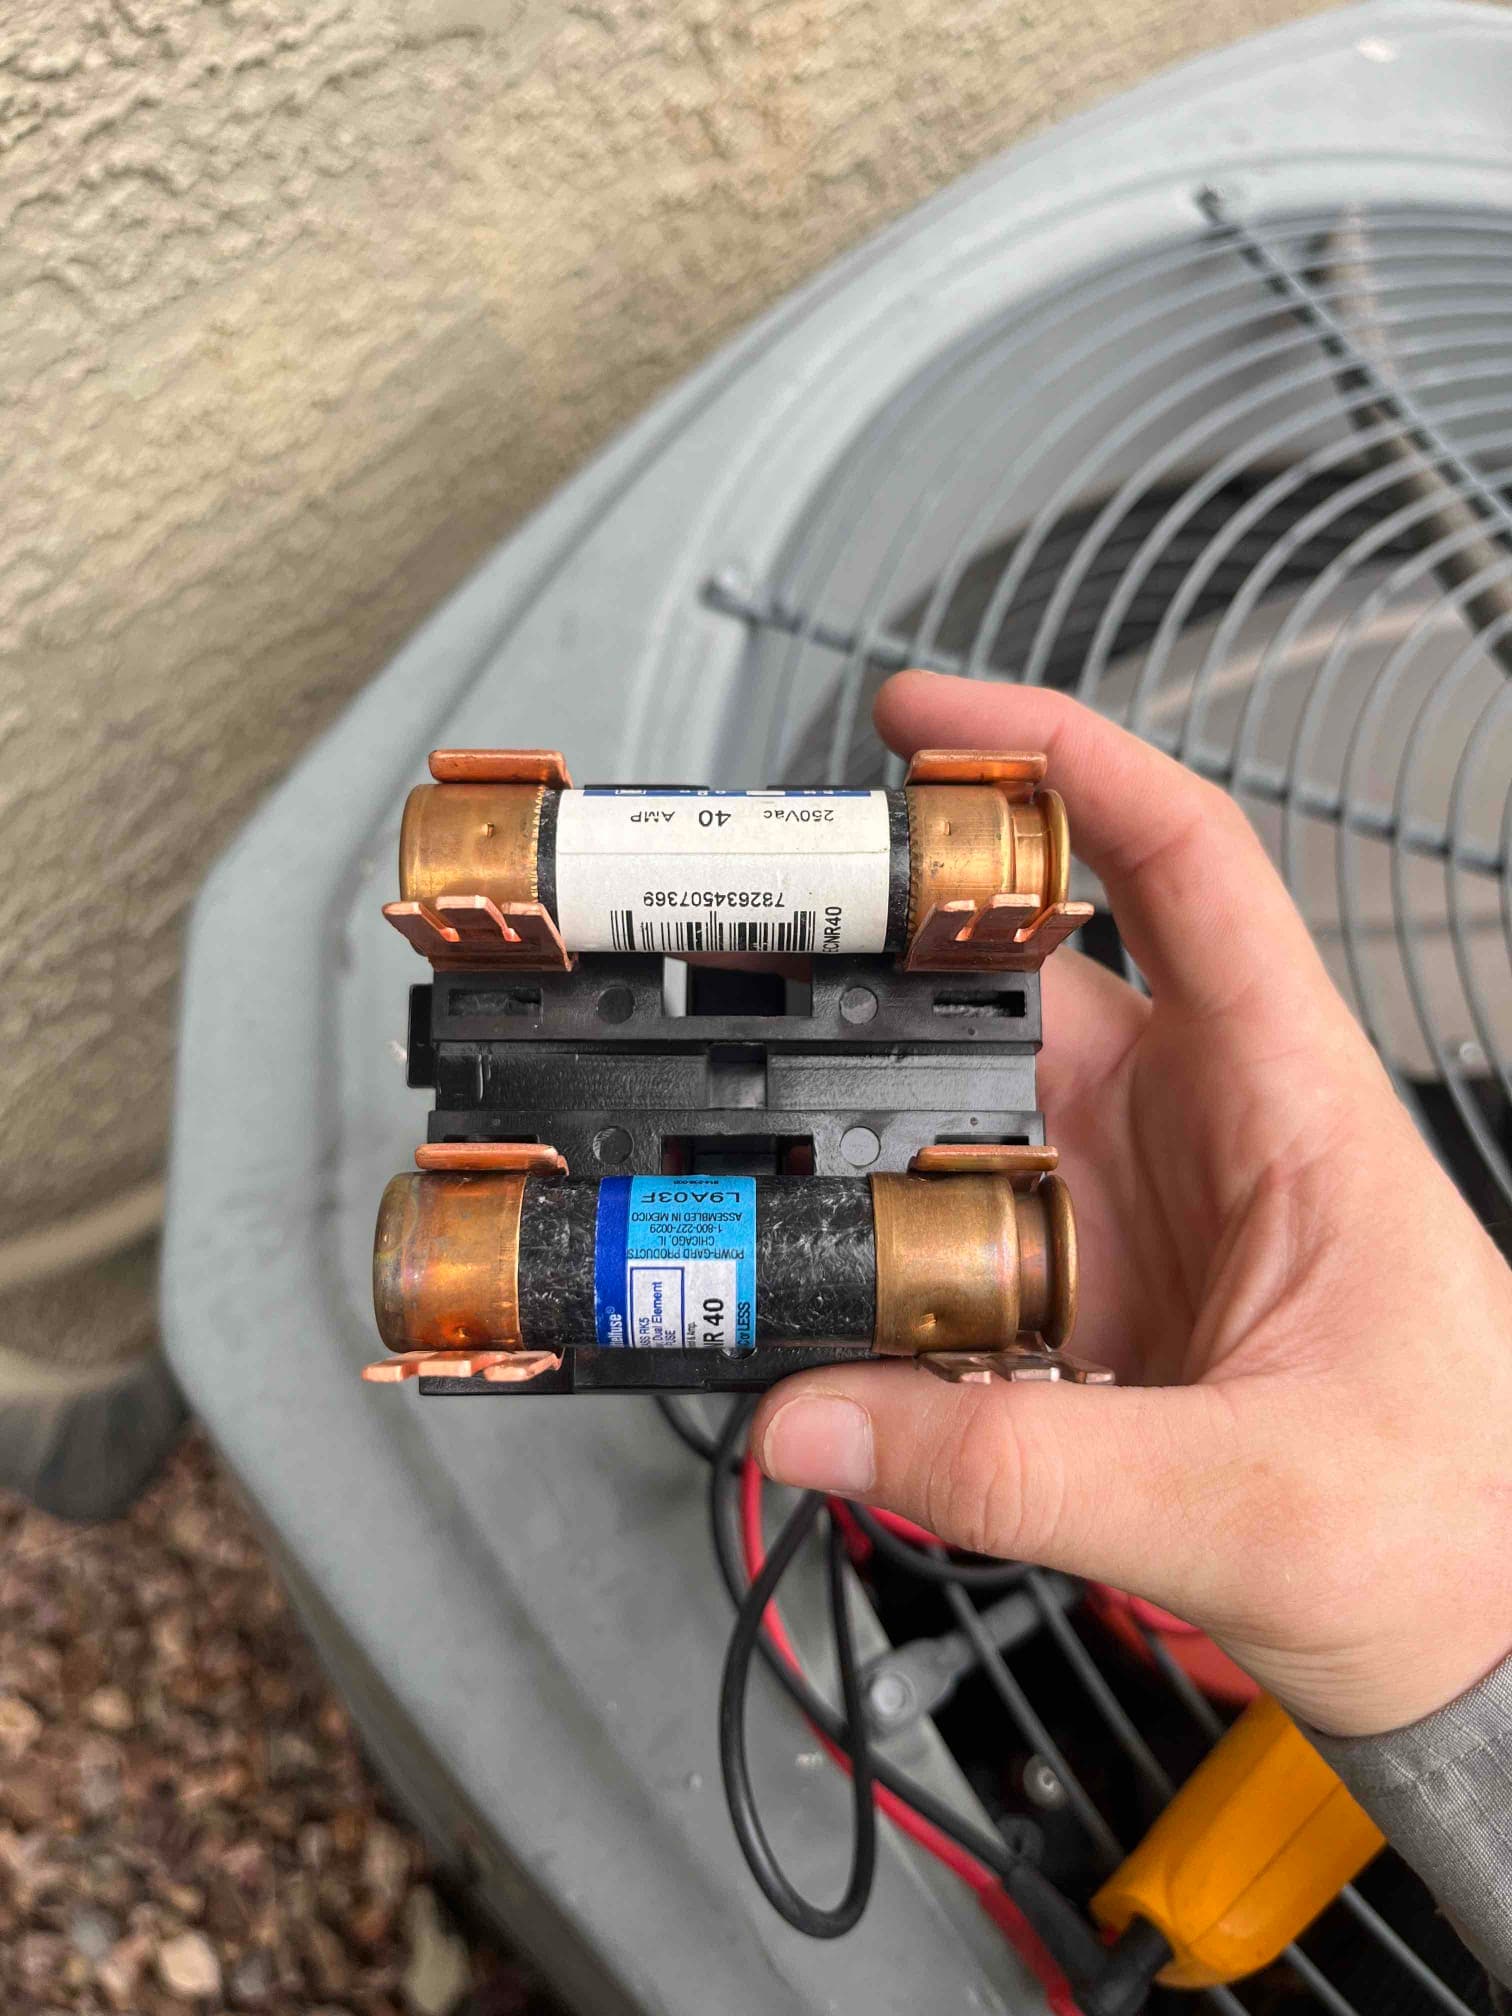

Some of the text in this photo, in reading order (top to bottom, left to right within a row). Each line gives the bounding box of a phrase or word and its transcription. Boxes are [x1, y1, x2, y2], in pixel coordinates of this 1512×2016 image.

[630, 809, 835, 827] 250Vac 40 AMP
[640, 1191, 741, 1204] L9A03F
[631, 1212, 743, 1222] ASSEMBLED IN MEXICO
[649, 1223, 723, 1233] 1-800-227-0029
[659, 1235, 715, 1246] CHICAGO, IL
[627, 1248, 745, 1260] POWR-GARD PRODUCTS
[651, 1281, 663, 1323] Element
[702, 1298, 724, 1327] 40
[737, 1301, 751, 1331] LESS
[638, 1317, 650, 1332] RK5
